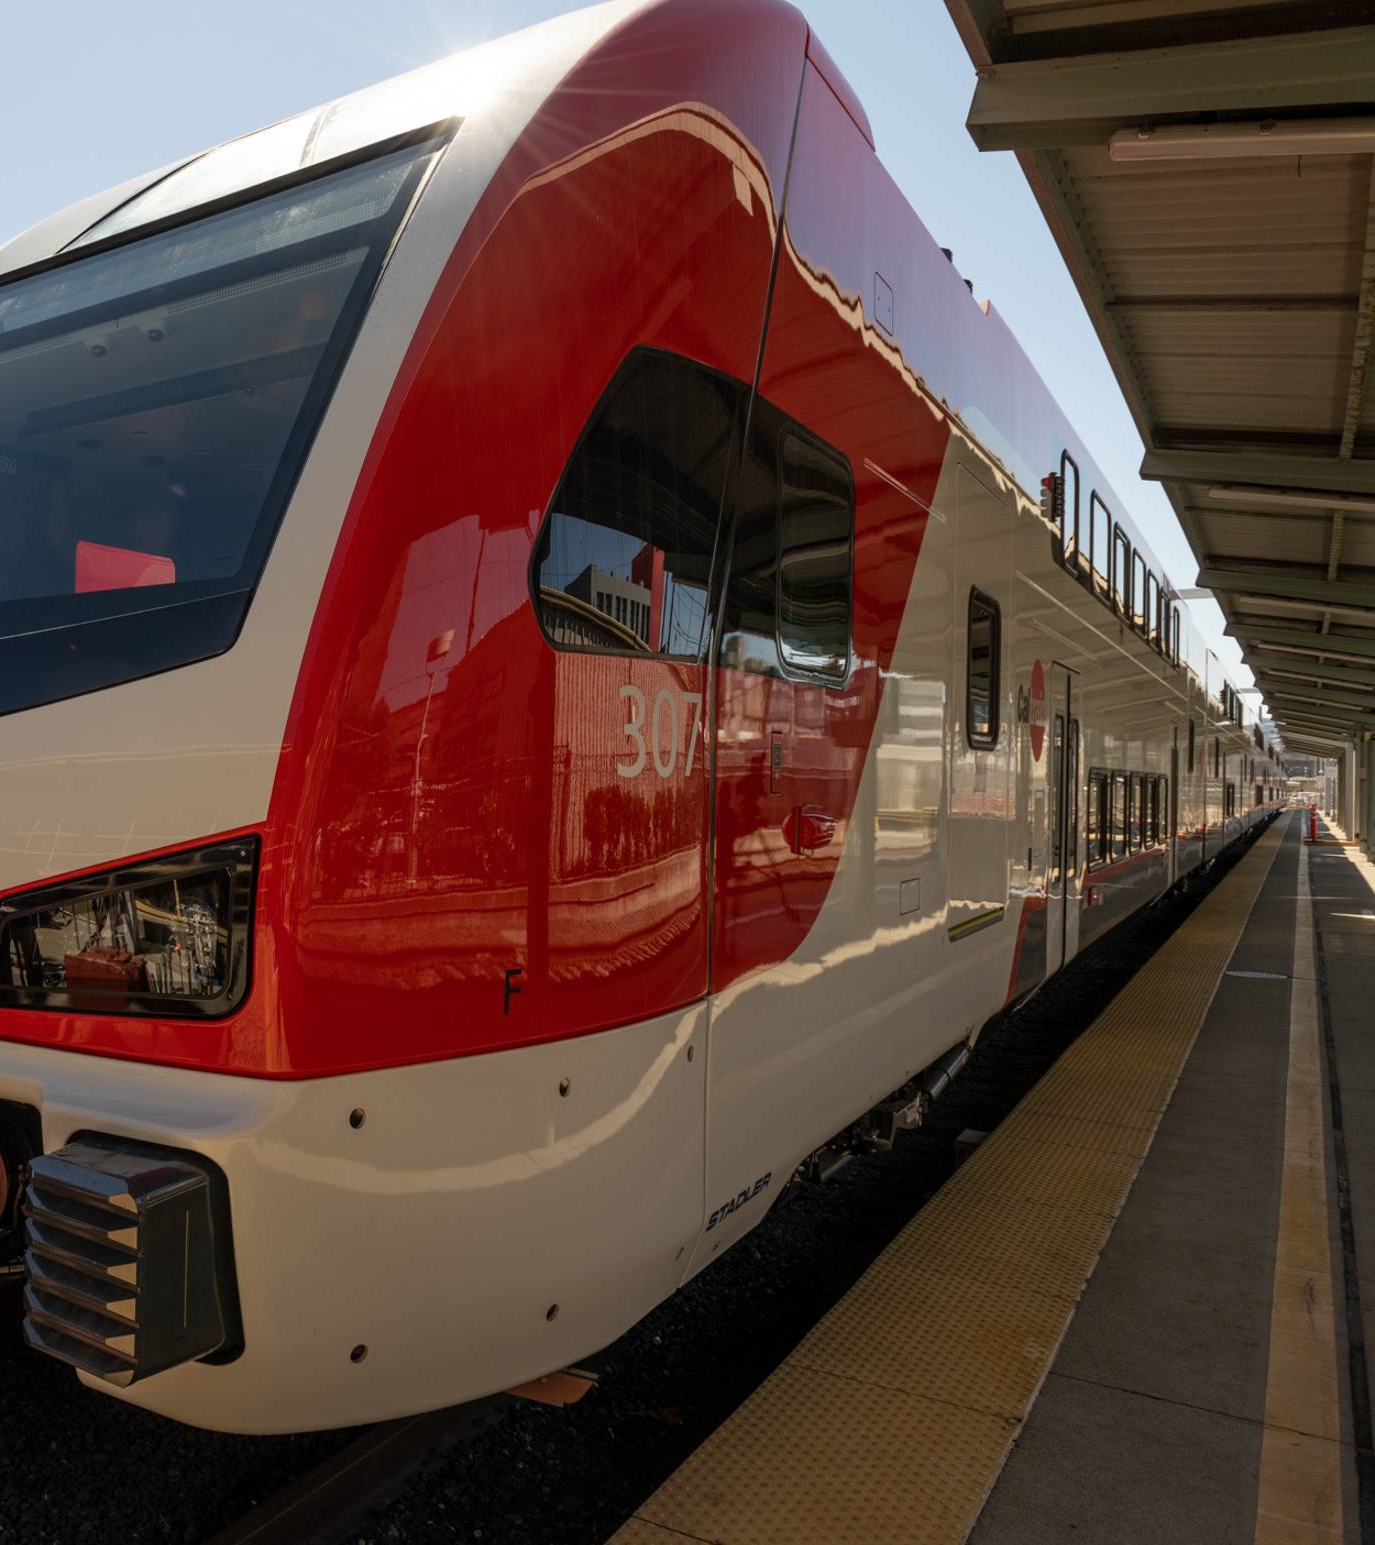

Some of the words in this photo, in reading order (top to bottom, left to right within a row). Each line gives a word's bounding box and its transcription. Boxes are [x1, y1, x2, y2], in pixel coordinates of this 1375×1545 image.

[617, 685, 703, 778] 307
[504, 968, 522, 1015] F
[705, 1171, 772, 1232] STADLER
